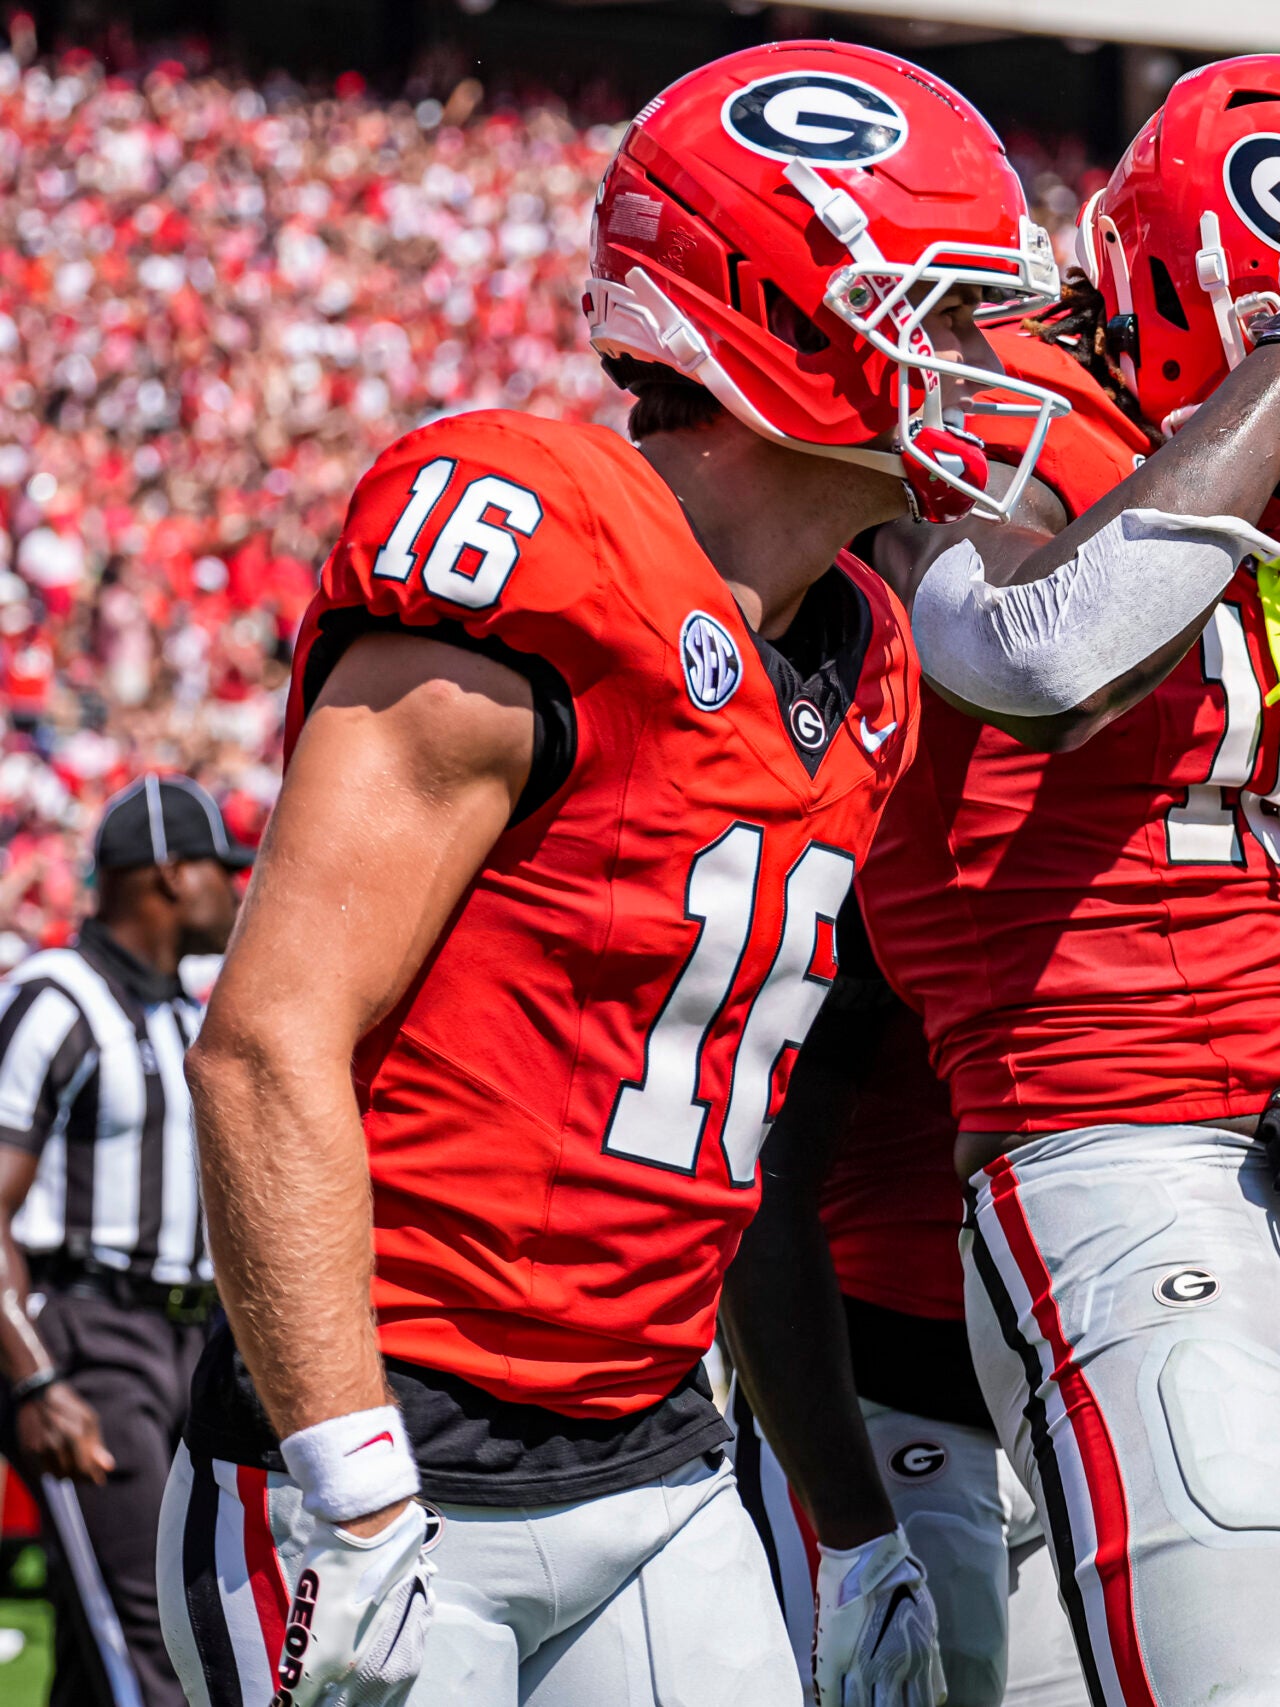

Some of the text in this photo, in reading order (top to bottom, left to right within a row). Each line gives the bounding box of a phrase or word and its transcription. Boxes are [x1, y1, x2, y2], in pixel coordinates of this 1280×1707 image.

[726, 74, 905, 164] G
[372, 456, 544, 611] 16
[685, 618, 737, 703] SEC
[792, 703, 825, 746] G
[602, 818, 856, 1190] 16
[1159, 1269, 1218, 1303] G
[889, 1441, 946, 1478] G
